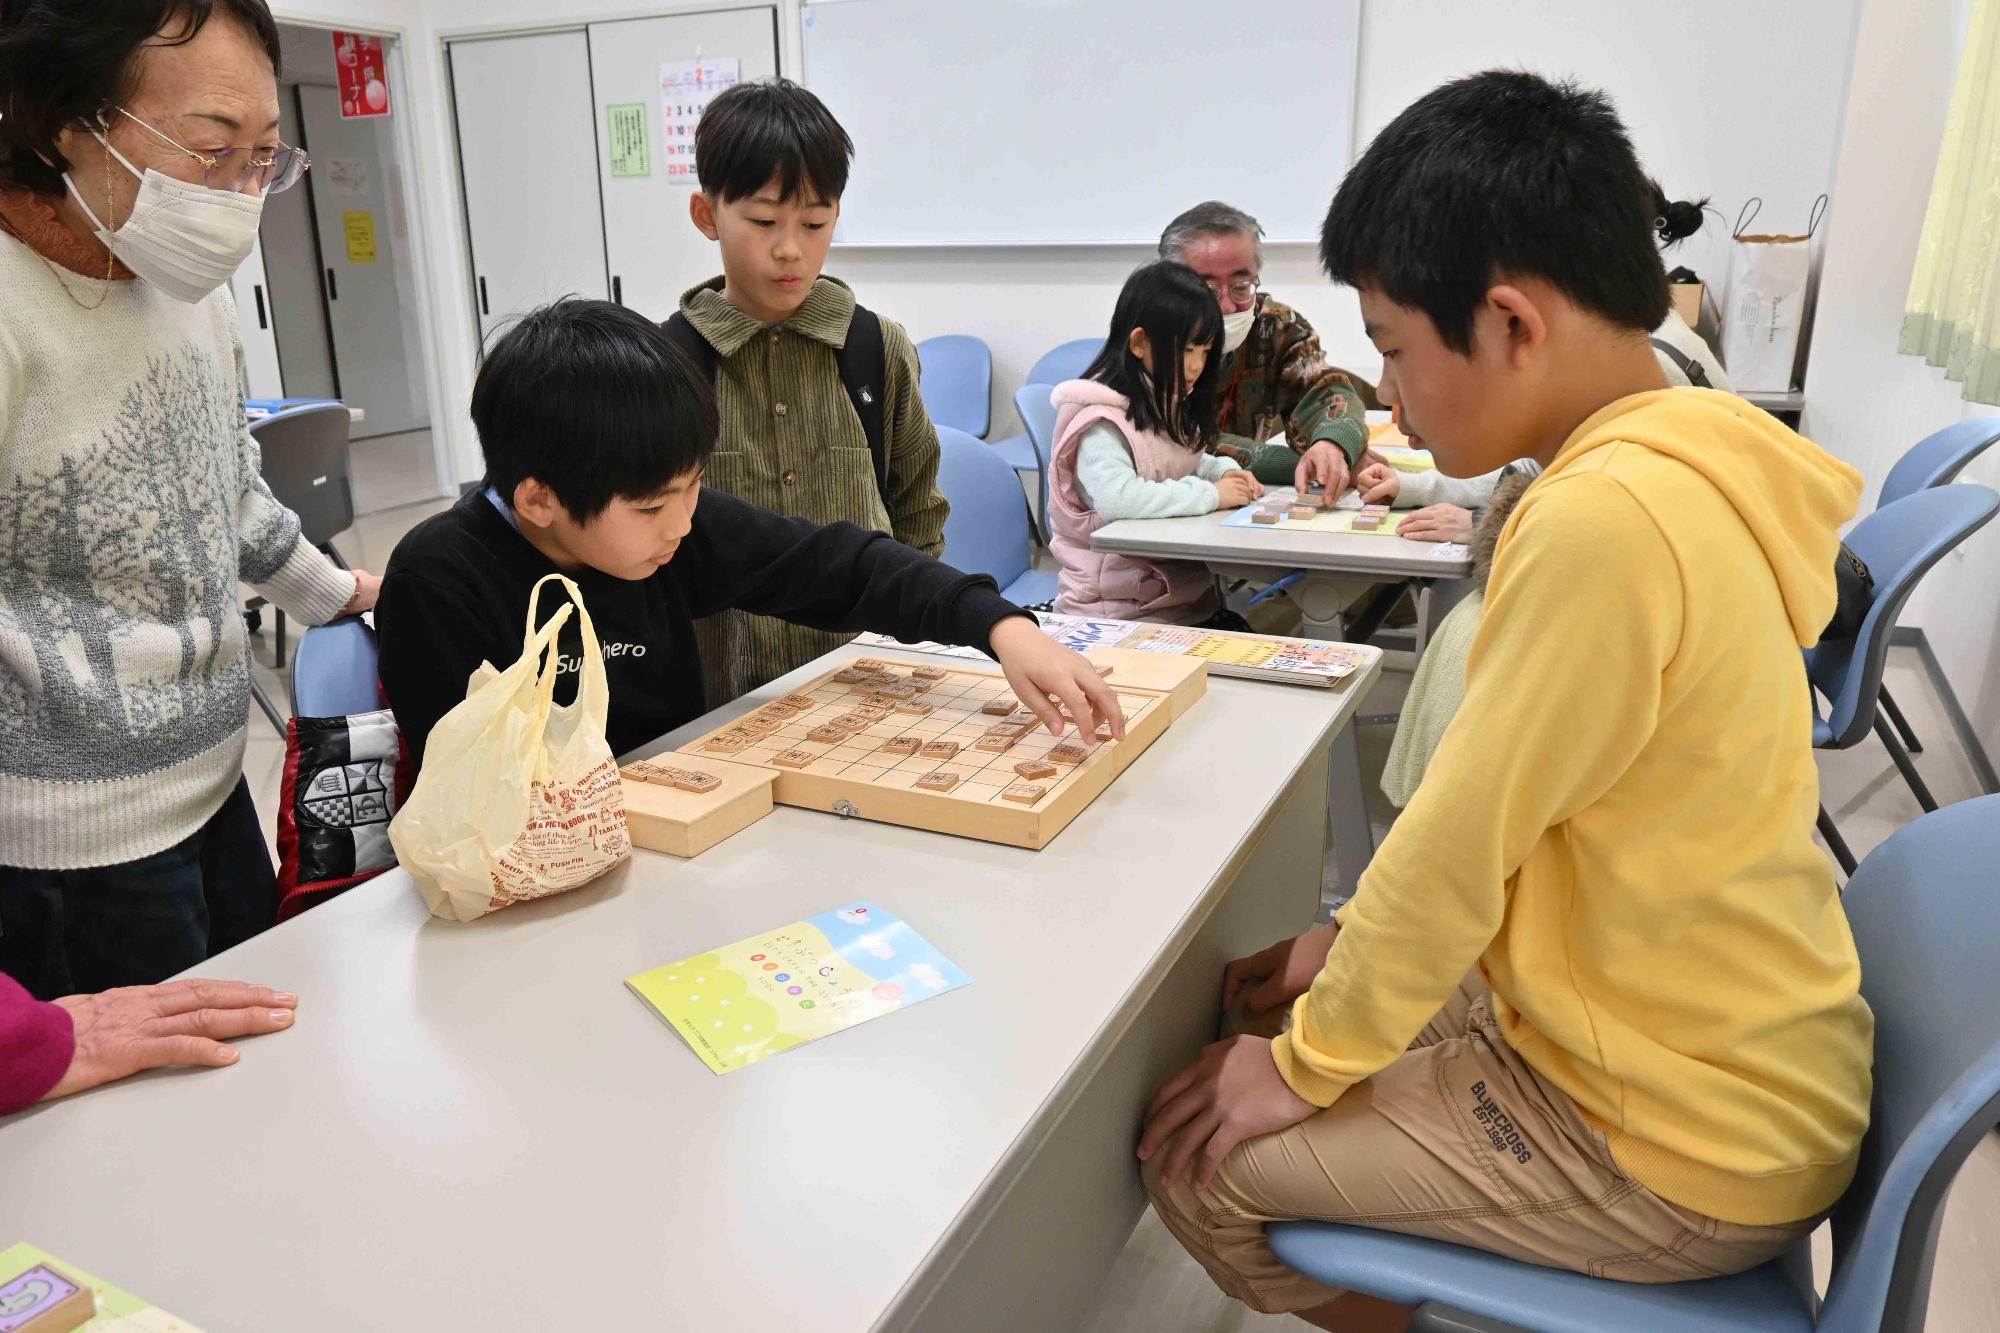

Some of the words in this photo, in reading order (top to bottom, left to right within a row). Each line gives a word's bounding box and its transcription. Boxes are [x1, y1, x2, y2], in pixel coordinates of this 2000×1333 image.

[695, 68, 703, 81] 2
[666, 106, 673, 116] 2
[676, 105, 683, 116] 3
[687, 105, 693, 116] 4
[667, 127, 673, 136] 9
[677, 125, 685, 136] 10
[667, 144, 676, 155] 16
[677, 144, 685, 155] 17
[668, 164, 677, 176] 23
[678, 164, 689, 175] 24
[557, 639, 646, 675] Suhero
[577, 762, 608, 787] making
[567, 814, 587, 829] BOOK
[543, 831, 550, 839] of
[599, 825, 619, 835] TABLE
[498, 859, 524, 875] kettle
[1470, 1080, 1532, 1165] BLUECROSS
